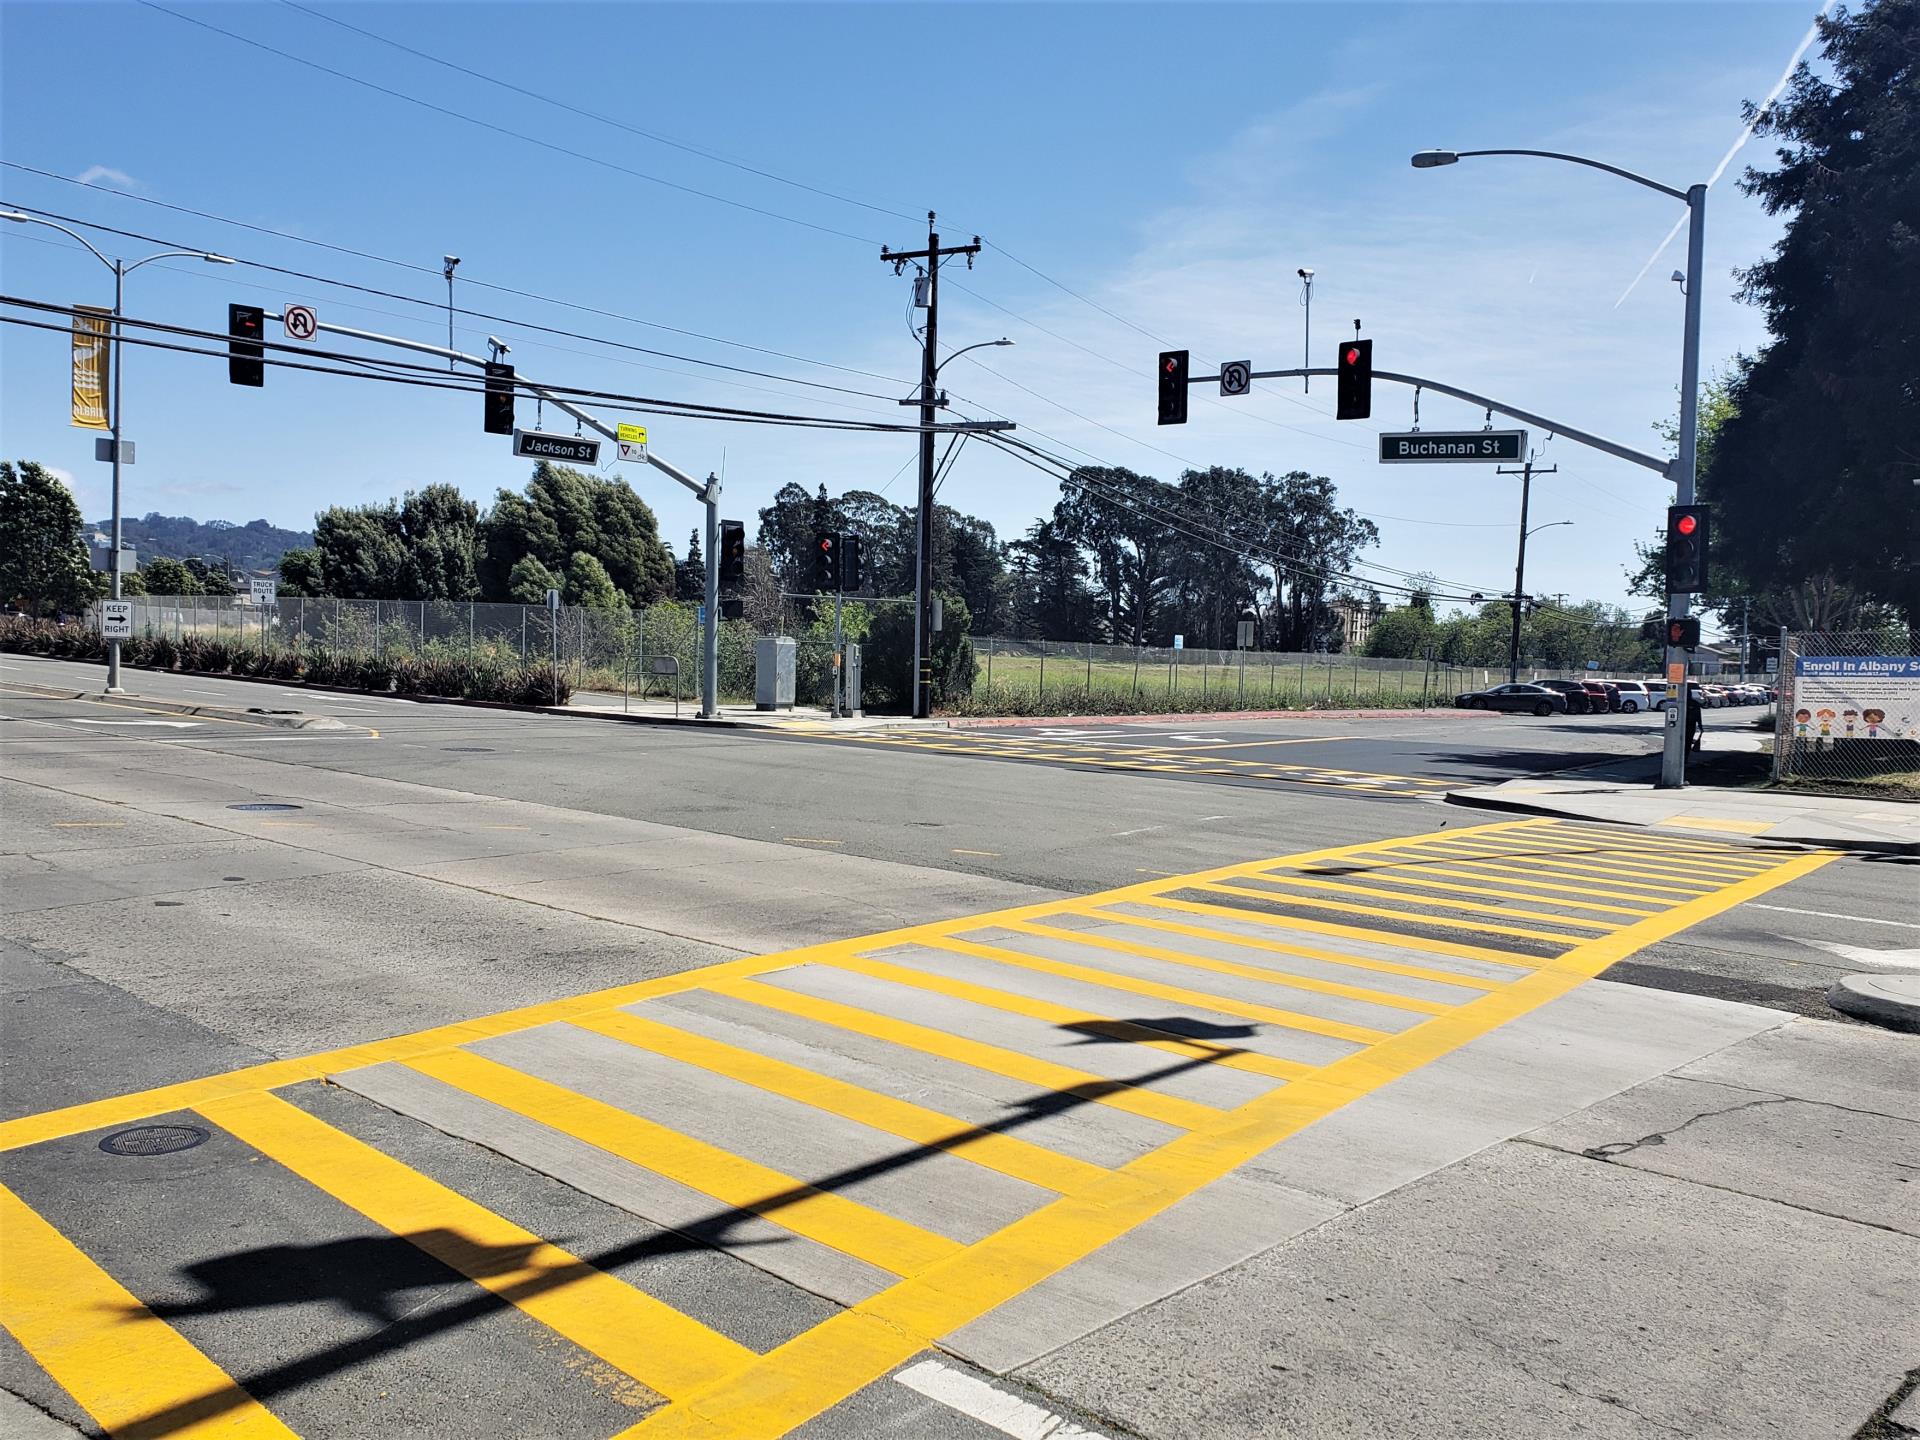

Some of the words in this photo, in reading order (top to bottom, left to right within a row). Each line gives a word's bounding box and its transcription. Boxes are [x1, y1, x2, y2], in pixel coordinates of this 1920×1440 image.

[526, 440, 574, 456] Jackson
[577, 446, 591, 458] St
[1399, 441, 1475, 455] Buchanan
[1482, 440, 1500, 454] St
[106, 605, 129, 613] KEEP
[104, 625, 130, 633] RIGHT
[1803, 661, 1840, 671] Enroll
[1843, 661, 1856, 671] In
[1859, 661, 1906, 673] Albany
[1910, 661, 1920, 671] S
